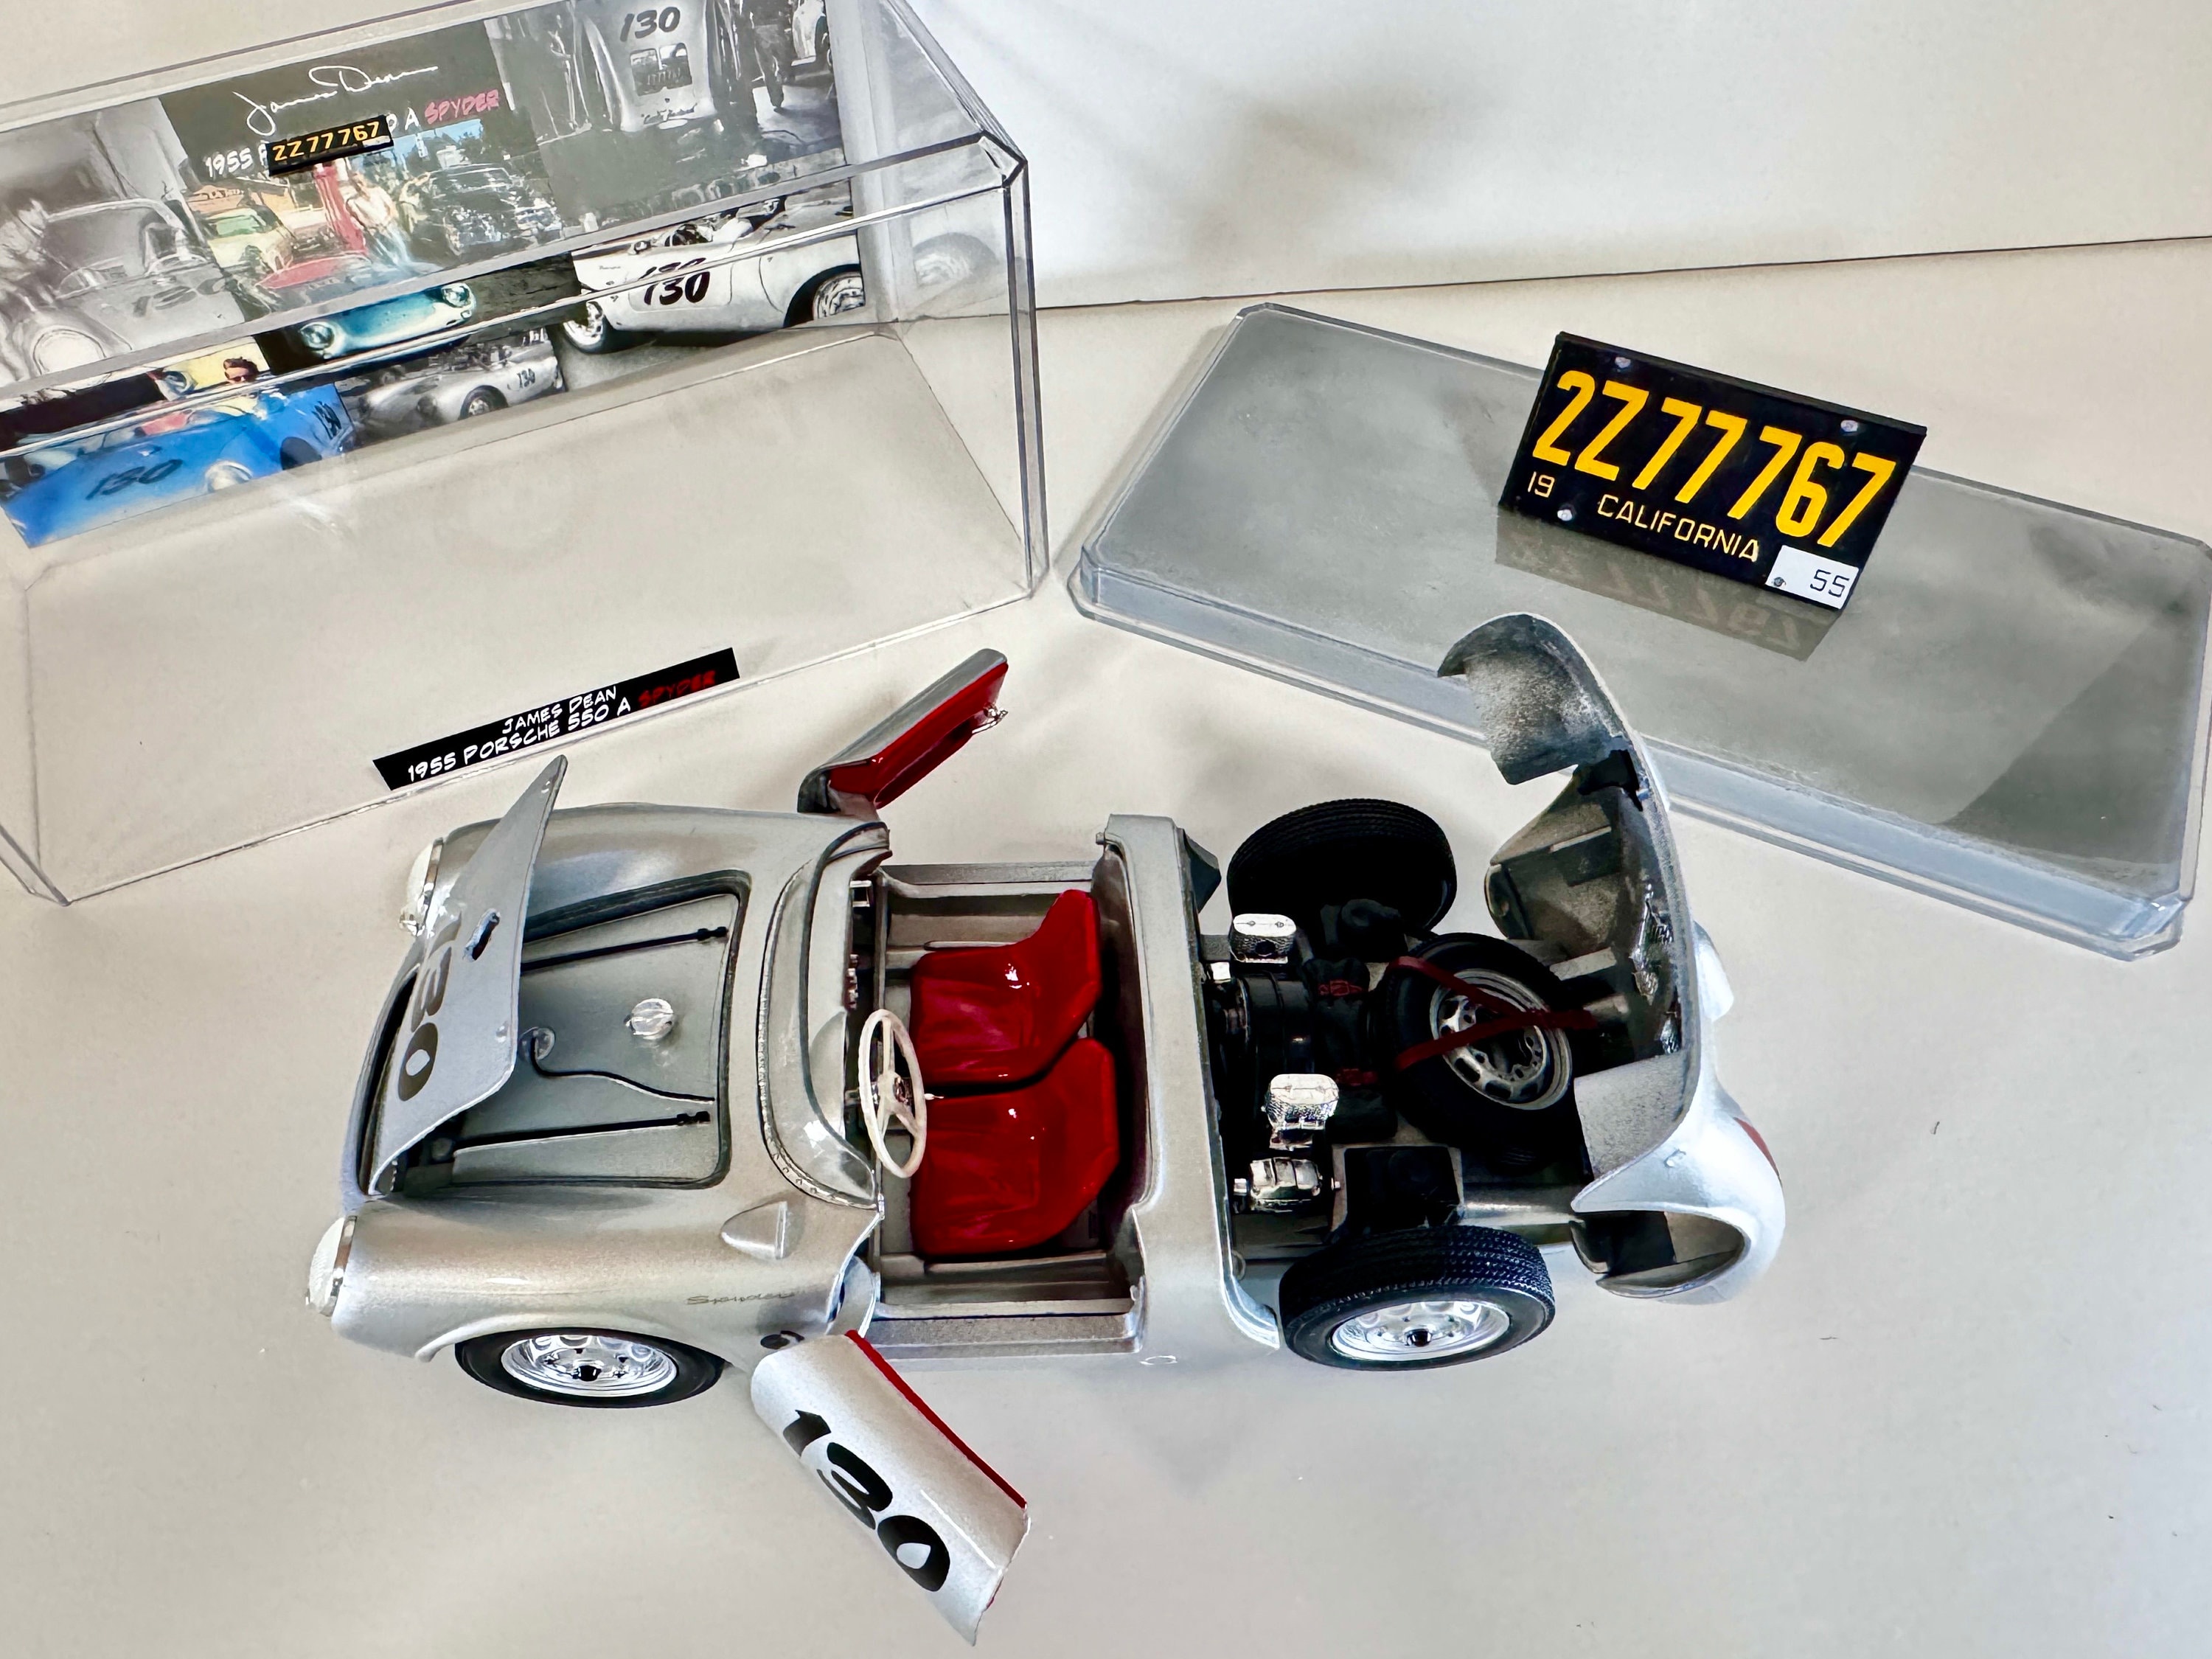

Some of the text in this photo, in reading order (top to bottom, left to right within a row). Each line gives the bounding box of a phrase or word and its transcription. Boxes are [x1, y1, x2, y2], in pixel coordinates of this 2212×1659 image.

[619, 7, 681, 42] 130
[204, 147, 253, 178] 1955
[405, 106, 421, 131] A
[424, 88, 500, 125] SPYDER
[642, 267, 711, 306] 130
[85, 458, 184, 501] 130
[1527, 470, 1851, 598] 19 CALIFORNIA 55
[408, 669, 716, 782] 1955 PORSCHE 550 A SPYDER
[501, 686, 617, 734] JAMES DEAN
[782, 1409, 951, 1593] 130
